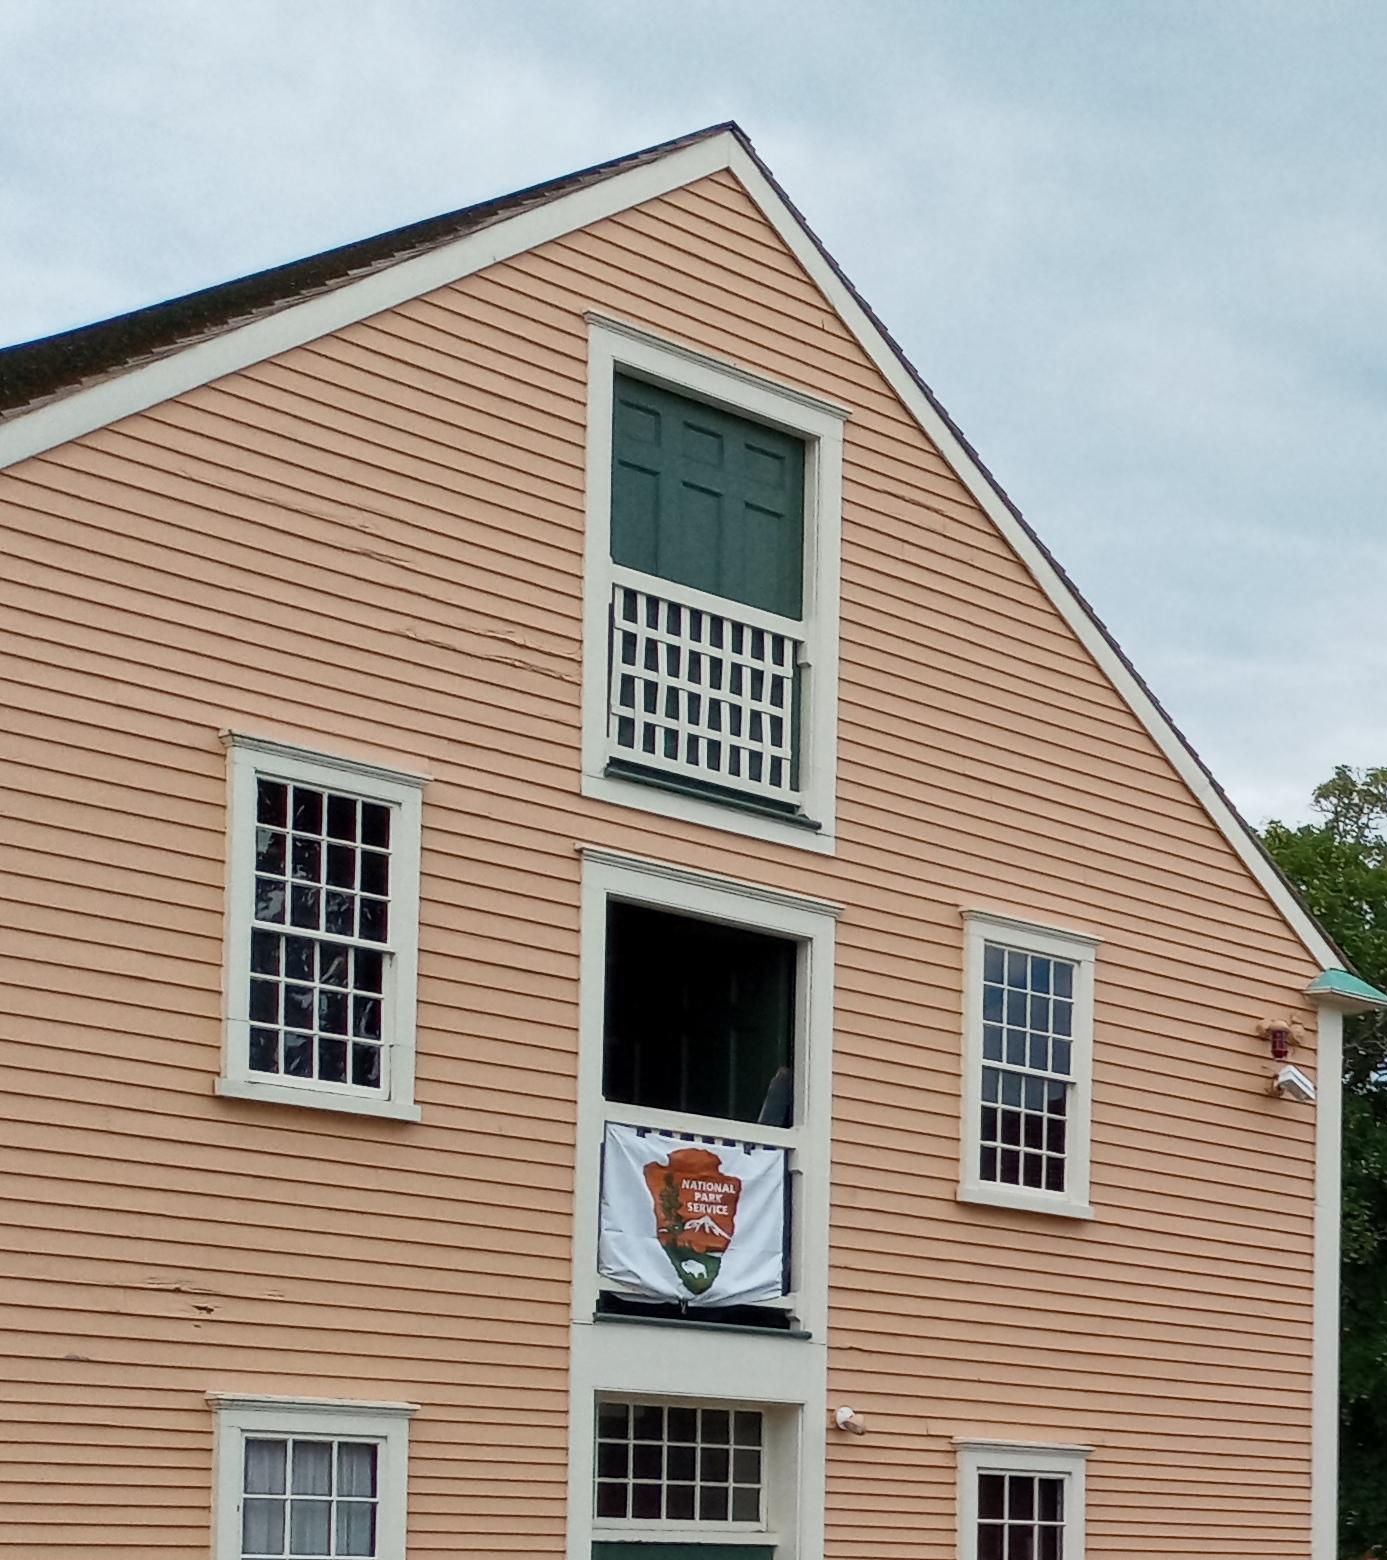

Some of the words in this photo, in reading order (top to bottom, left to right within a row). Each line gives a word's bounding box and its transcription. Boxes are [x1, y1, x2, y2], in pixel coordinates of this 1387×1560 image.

[681, 1179, 736, 1194] NATIONAL
[694, 1192, 724, 1203] PARK
[687, 1202, 729, 1215] SERVICE
